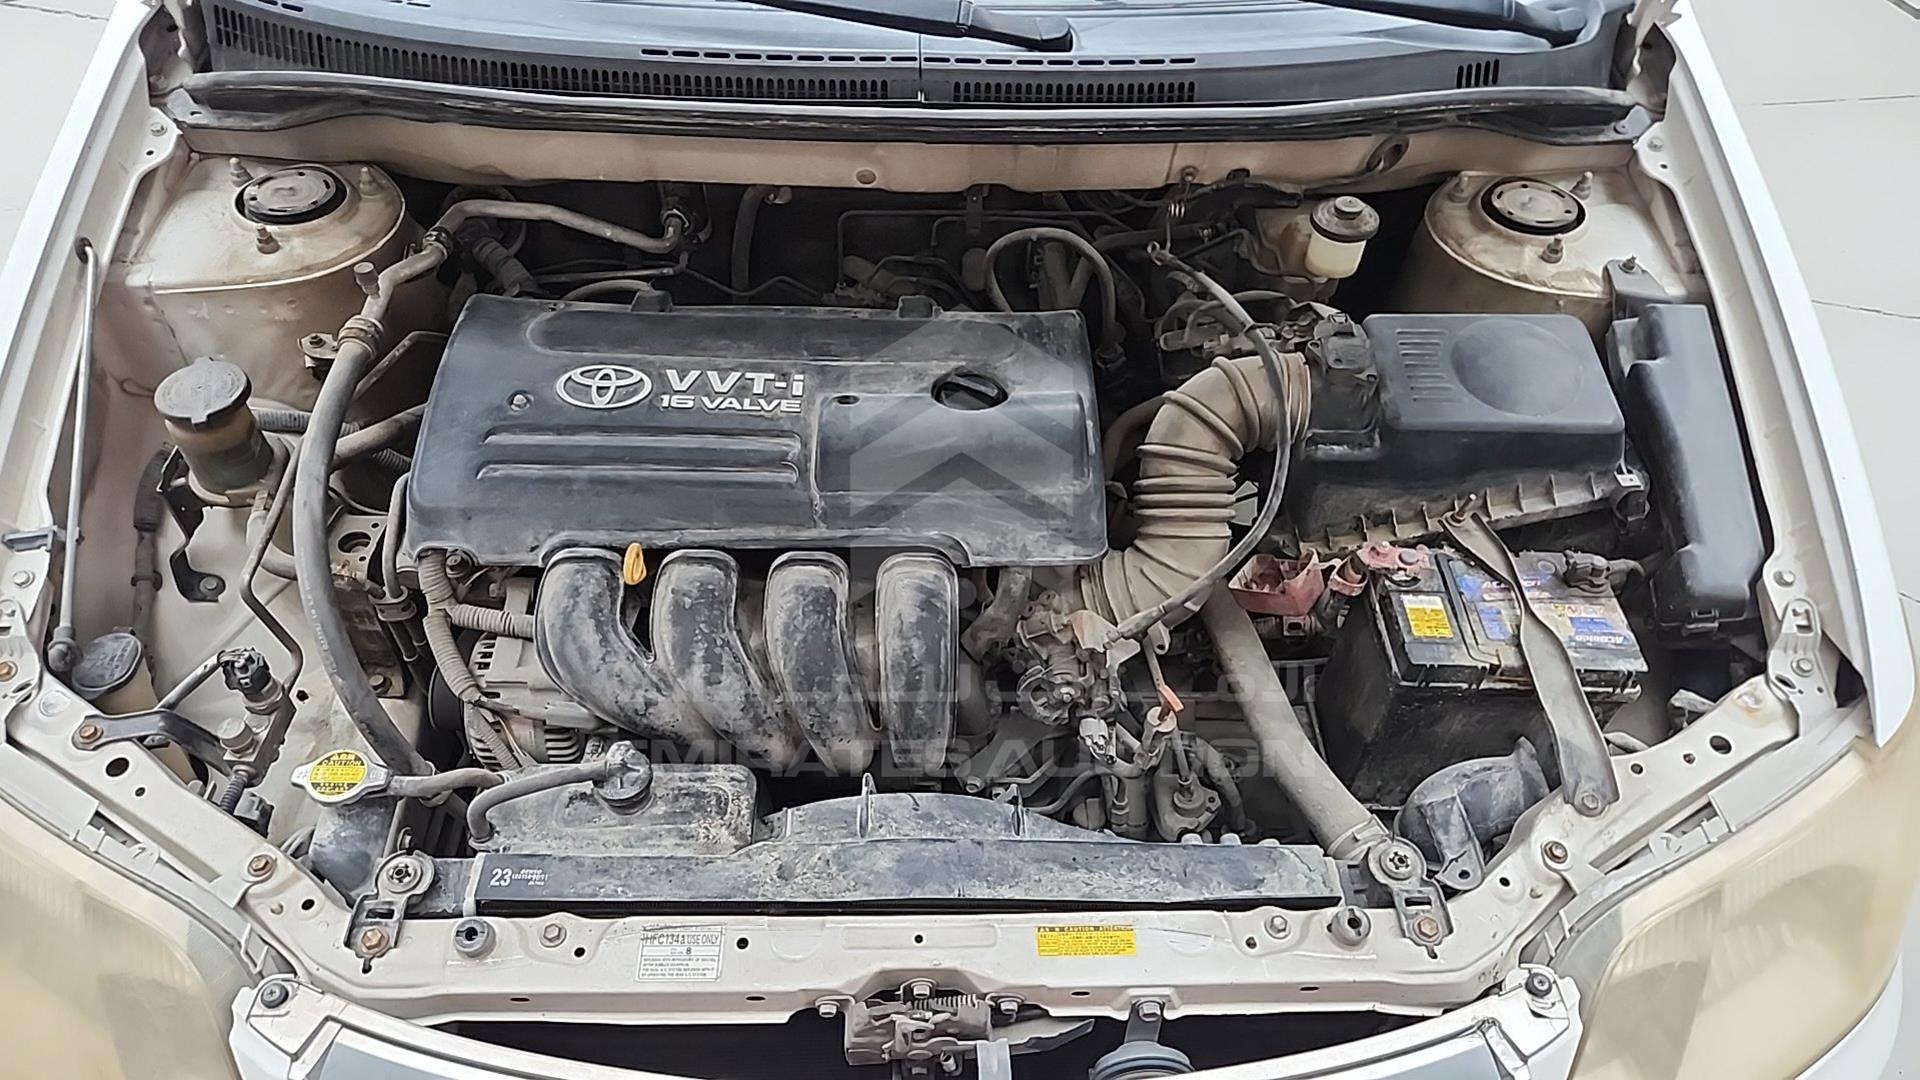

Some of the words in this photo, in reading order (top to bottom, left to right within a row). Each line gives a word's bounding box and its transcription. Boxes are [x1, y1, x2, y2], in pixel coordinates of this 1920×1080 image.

[665, 369, 804, 396] VVT-i
[660, 394, 695, 408] 16
[701, 396, 801, 413] VALVE
[489, 868, 512, 886] 23
[687, 933, 700, 944] USE
[702, 933, 719, 944] ONLY
